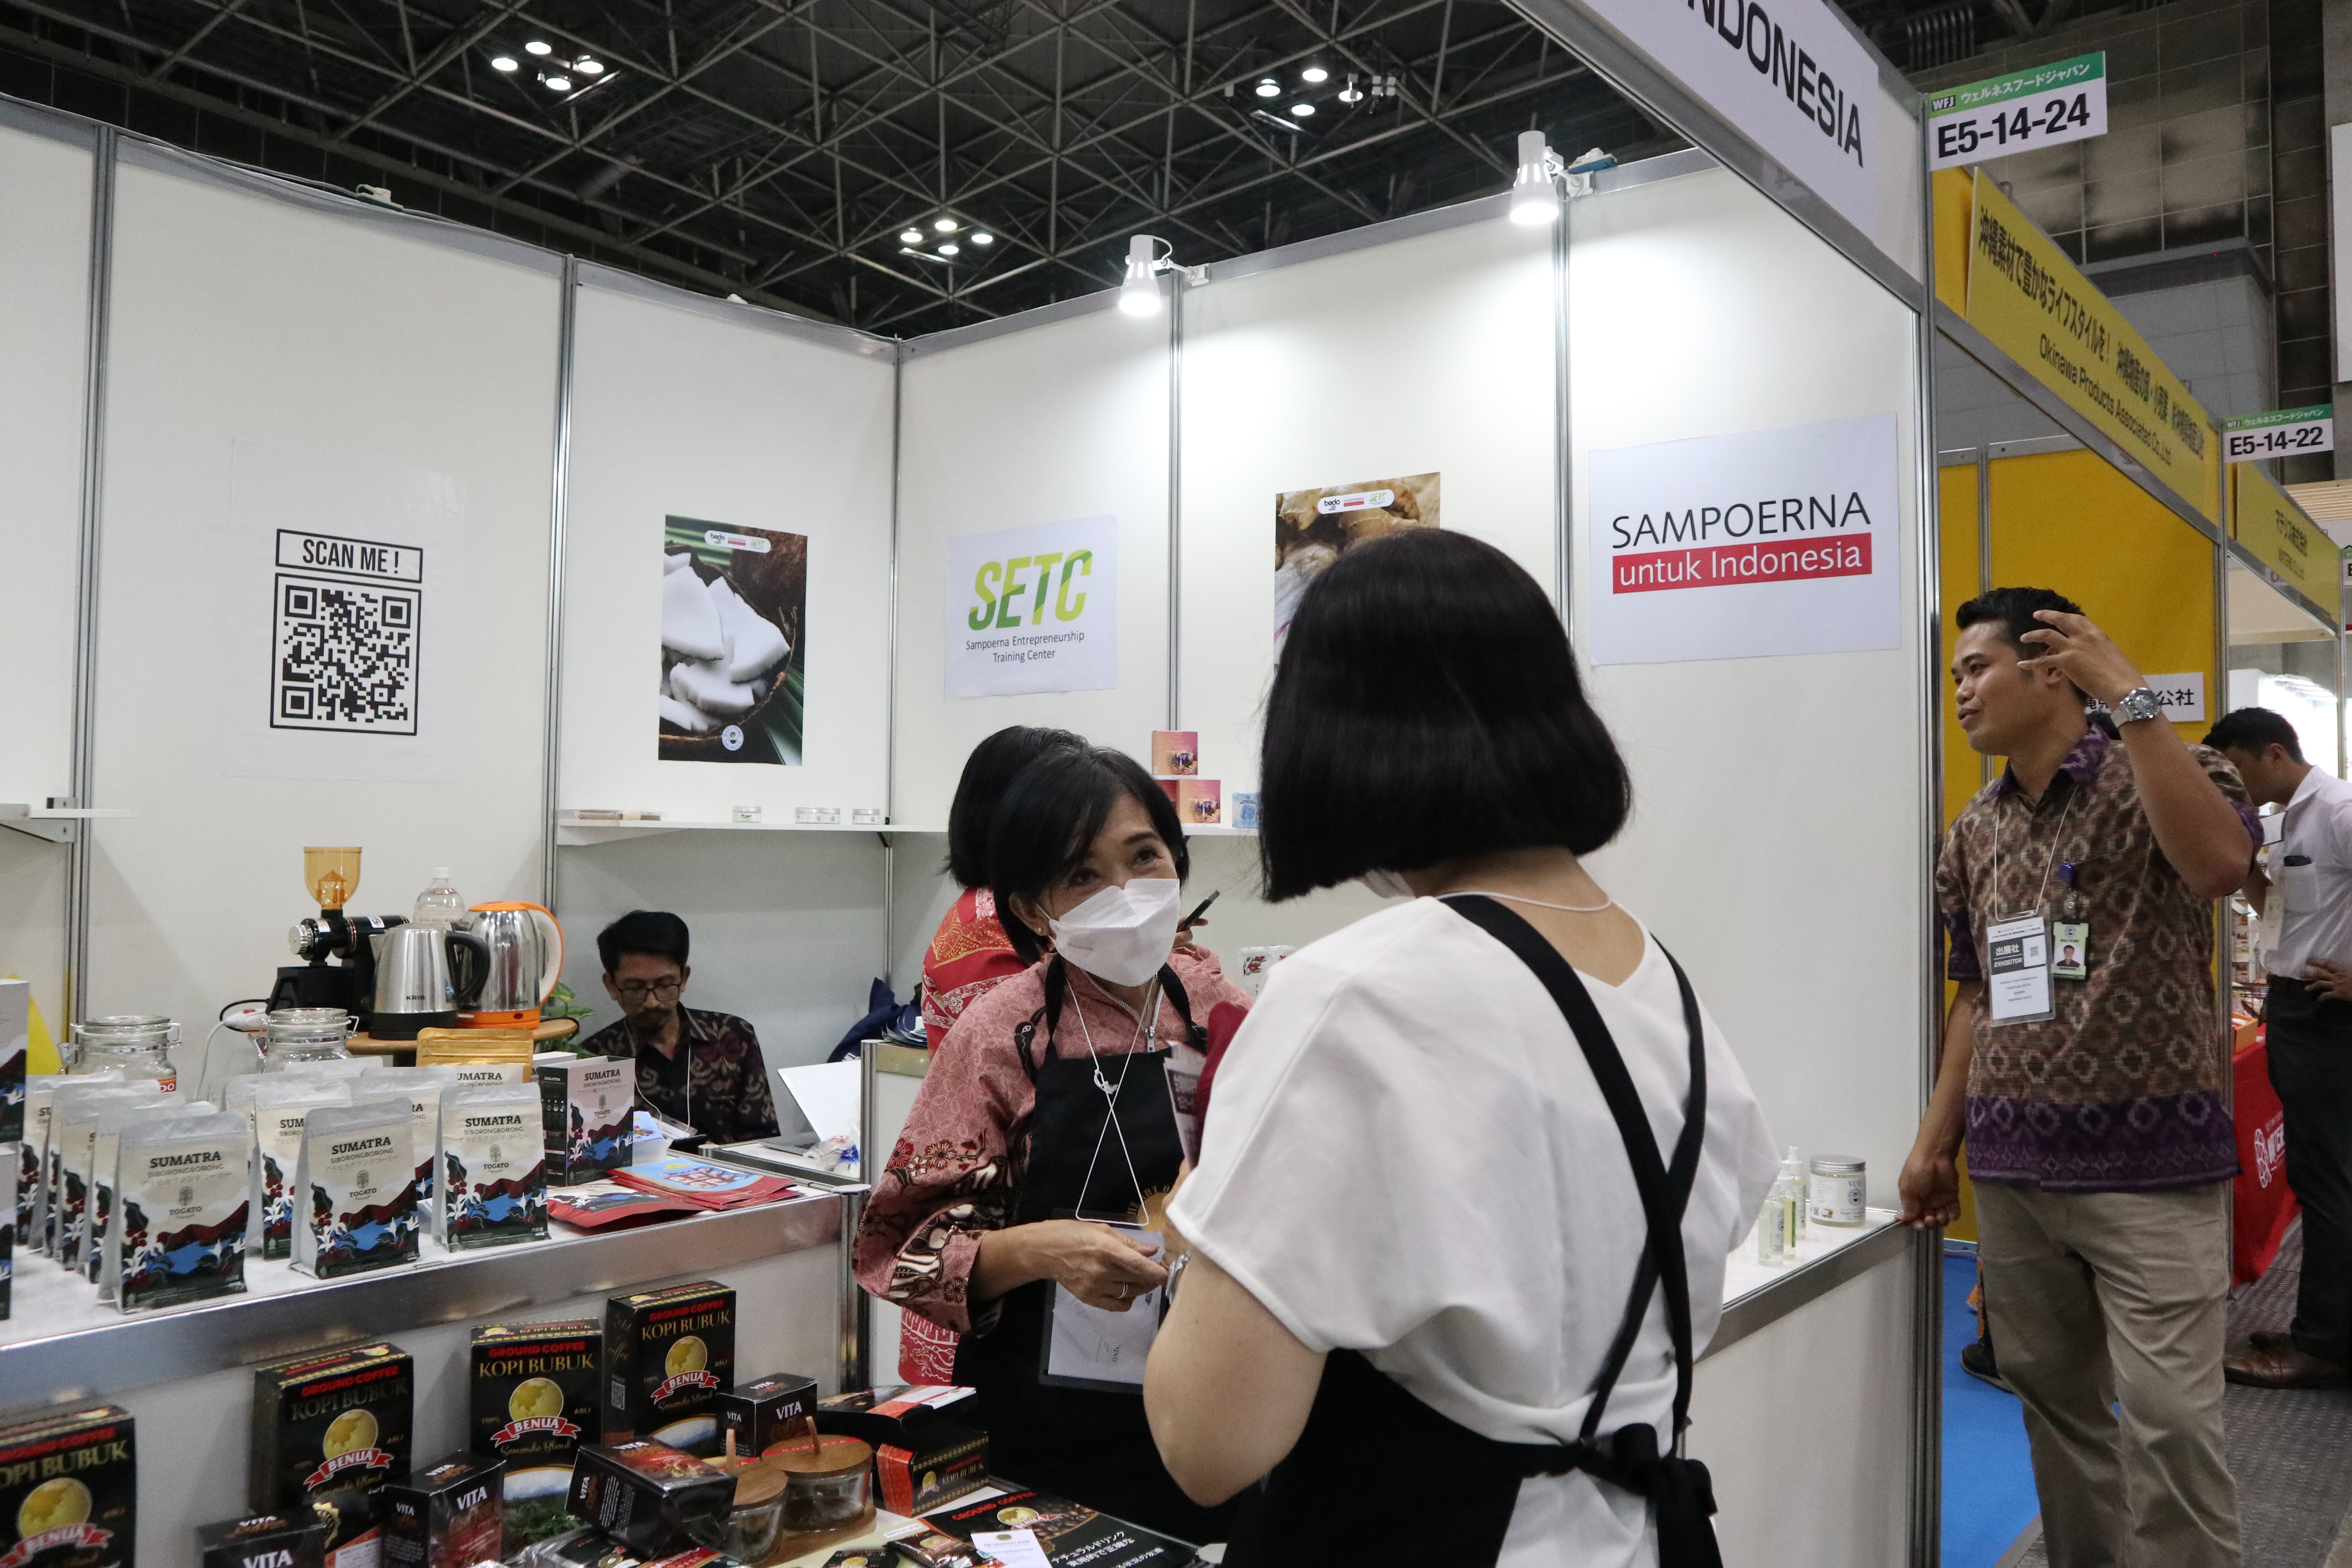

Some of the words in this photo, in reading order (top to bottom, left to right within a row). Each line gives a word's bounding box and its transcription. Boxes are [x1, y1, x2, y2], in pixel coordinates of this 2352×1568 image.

[1932, 96, 1955, 111] WFJ
[1960, 64, 2091, 104] ウェルネスフードジャパン
[1938, 93, 2090, 158] E5-14-24
[2040, 333, 2077, 384] Okinawa
[2230, 426, 2323, 456] E5-14-22
[1369, 492, 1387, 502] SETC
[1612, 492, 1871, 549] SAMPOERNA
[302, 539, 354, 568] SCAN
[360, 546, 388, 573] ME
[1620, 551, 1702, 586] untuk
[1711, 541, 1862, 578] Indonesia
[968, 549, 1093, 631] SETC
[966, 638, 1009, 651] Sampoerna
[1013, 630, 1085, 646] Entrepreneurship
[993, 652, 1025, 663] Training
[1027, 649, 1056, 660] Center
[1996, 944, 2020, 956] 出展社
[1994, 958, 2023, 968] EXHIBITOR
[457, 1072, 503, 1081] UMATRA
[583, 1078, 621, 1088] SIBORONGBORONG
[584, 1069, 620, 1081] SUMATRA
[280, 1118, 304, 1129] SUM
[465, 1115, 521, 1127] SUMATRA
[464, 1127, 524, 1135] SIBORONGBORONG
[332, 1137, 391, 1155] SUMATRA
[150, 1151, 222, 1169] SUMATRA
[330, 1148, 394, 1164] SIBORONGBORONG
[147, 1163, 224, 1178] SIBORONGBORONG
[349, 1188, 377, 1198] TOGATO
[169, 1206, 202, 1215] TOGATO
[650, 1308, 690, 1322] GROUND
[690, 1299, 725, 1314] COFFEE
[641, 1321, 677, 1341] KOPI
[680, 1310, 730, 1333] BUBUK
[488, 1345, 541, 1358] GROUND
[542, 1341, 586, 1353] COFFEE
[479, 1359, 524, 1377] KOPI
[529, 1353, 595, 1373] BUBUK
[301, 1376, 354, 1397] GROUND
[355, 1365, 399, 1385] COFFEE
[669, 1372, 704, 1390] BENUA
[749, 1381, 775, 1390] VITA
[291, 1393, 338, 1421] KOPI
[342, 1377, 408, 1409] BUBUK
[727, 1411, 742, 1423] VITA
[776, 1401, 802, 1420] VITA
[513, 1417, 559, 1432] BENUA
[612, 1441, 650, 1450] VITA
[327, 1450, 373, 1473] BENUA
[579, 1476, 590, 1499] VITA
[942, 1472, 959, 1485] KOPI
[456, 1486, 488, 1511] VITA
[951, 1503, 997, 1521] GROUND
[997, 1491, 1037, 1505] COFFEE
[396, 1503, 415, 1517] VITA
[1015, 1516, 1045, 1529] BENUA
[242, 1549, 294, 1568] VITA
